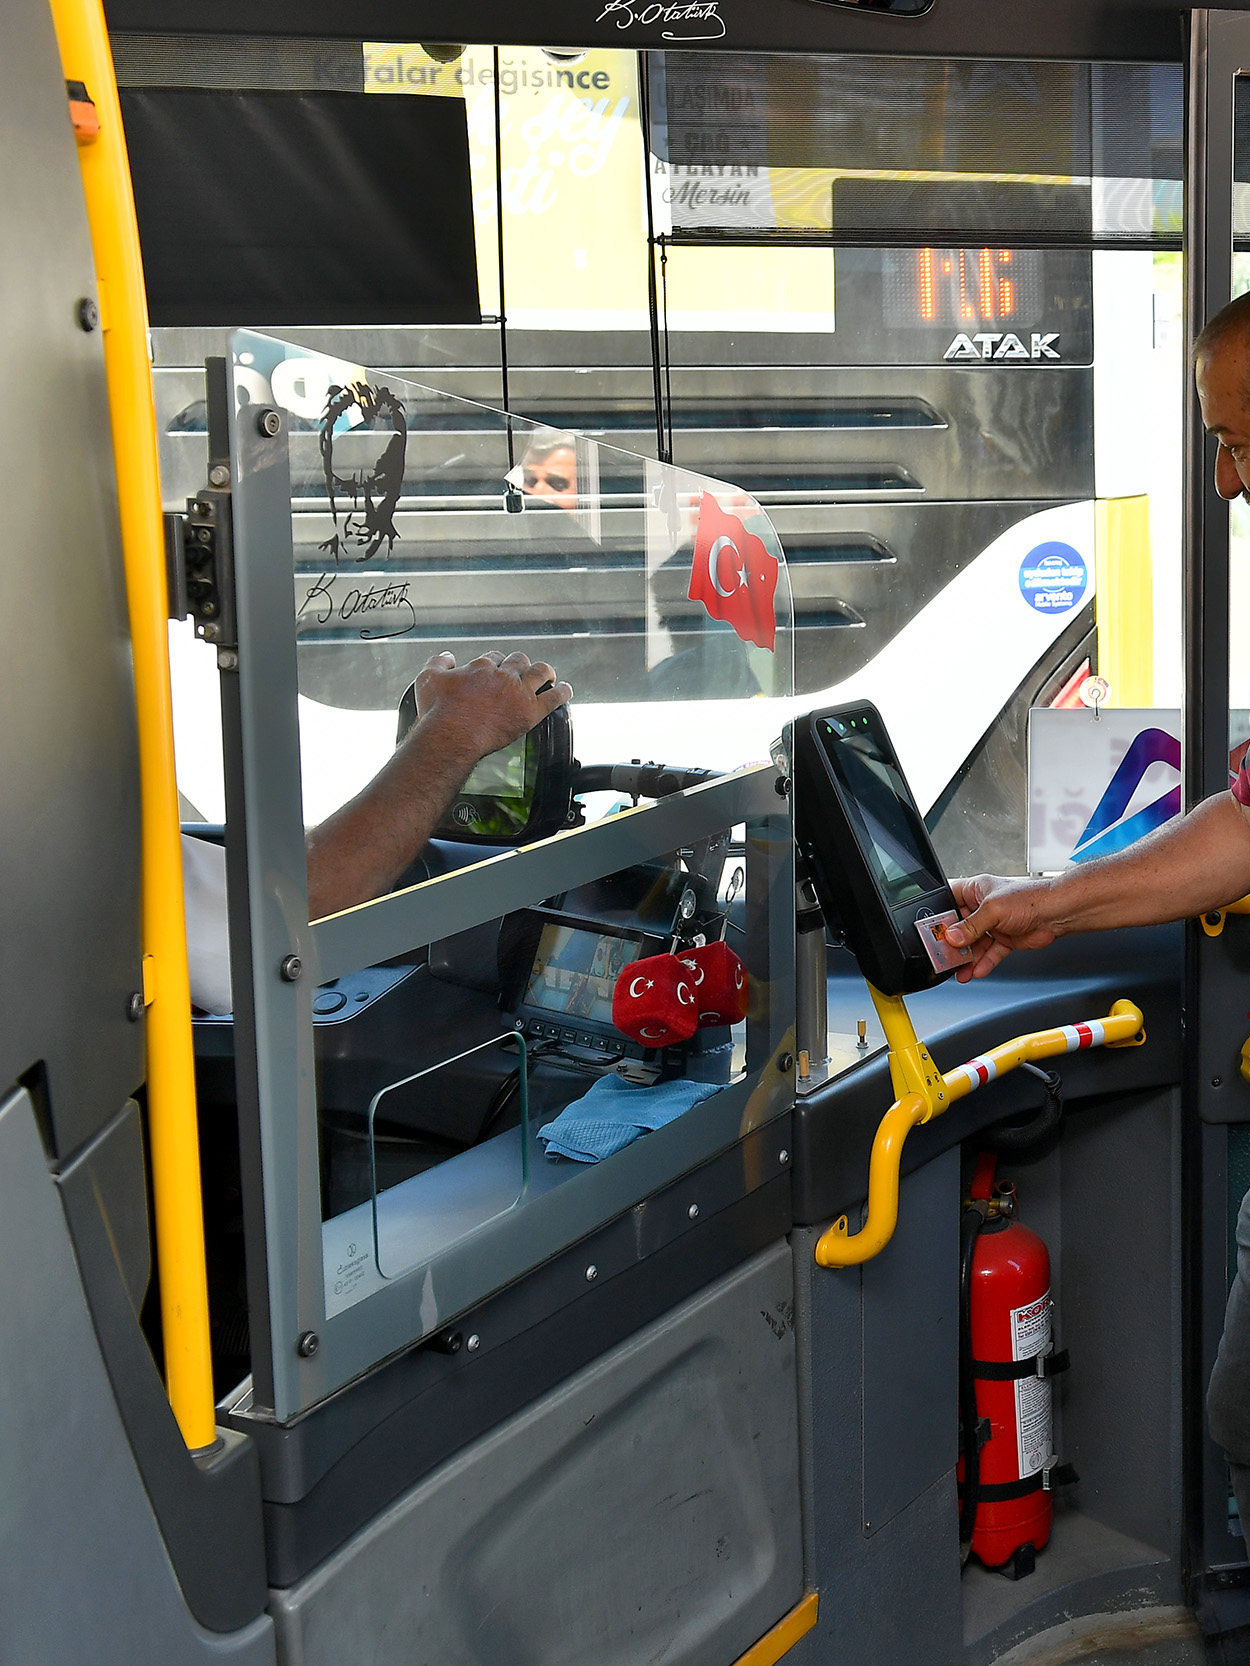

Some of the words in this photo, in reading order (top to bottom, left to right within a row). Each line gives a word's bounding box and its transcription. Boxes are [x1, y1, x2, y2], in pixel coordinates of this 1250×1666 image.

[454, 57, 610, 96] değişince
[661, 180, 751, 210] Mersin
[942, 332, 1062, 360] ATAK
